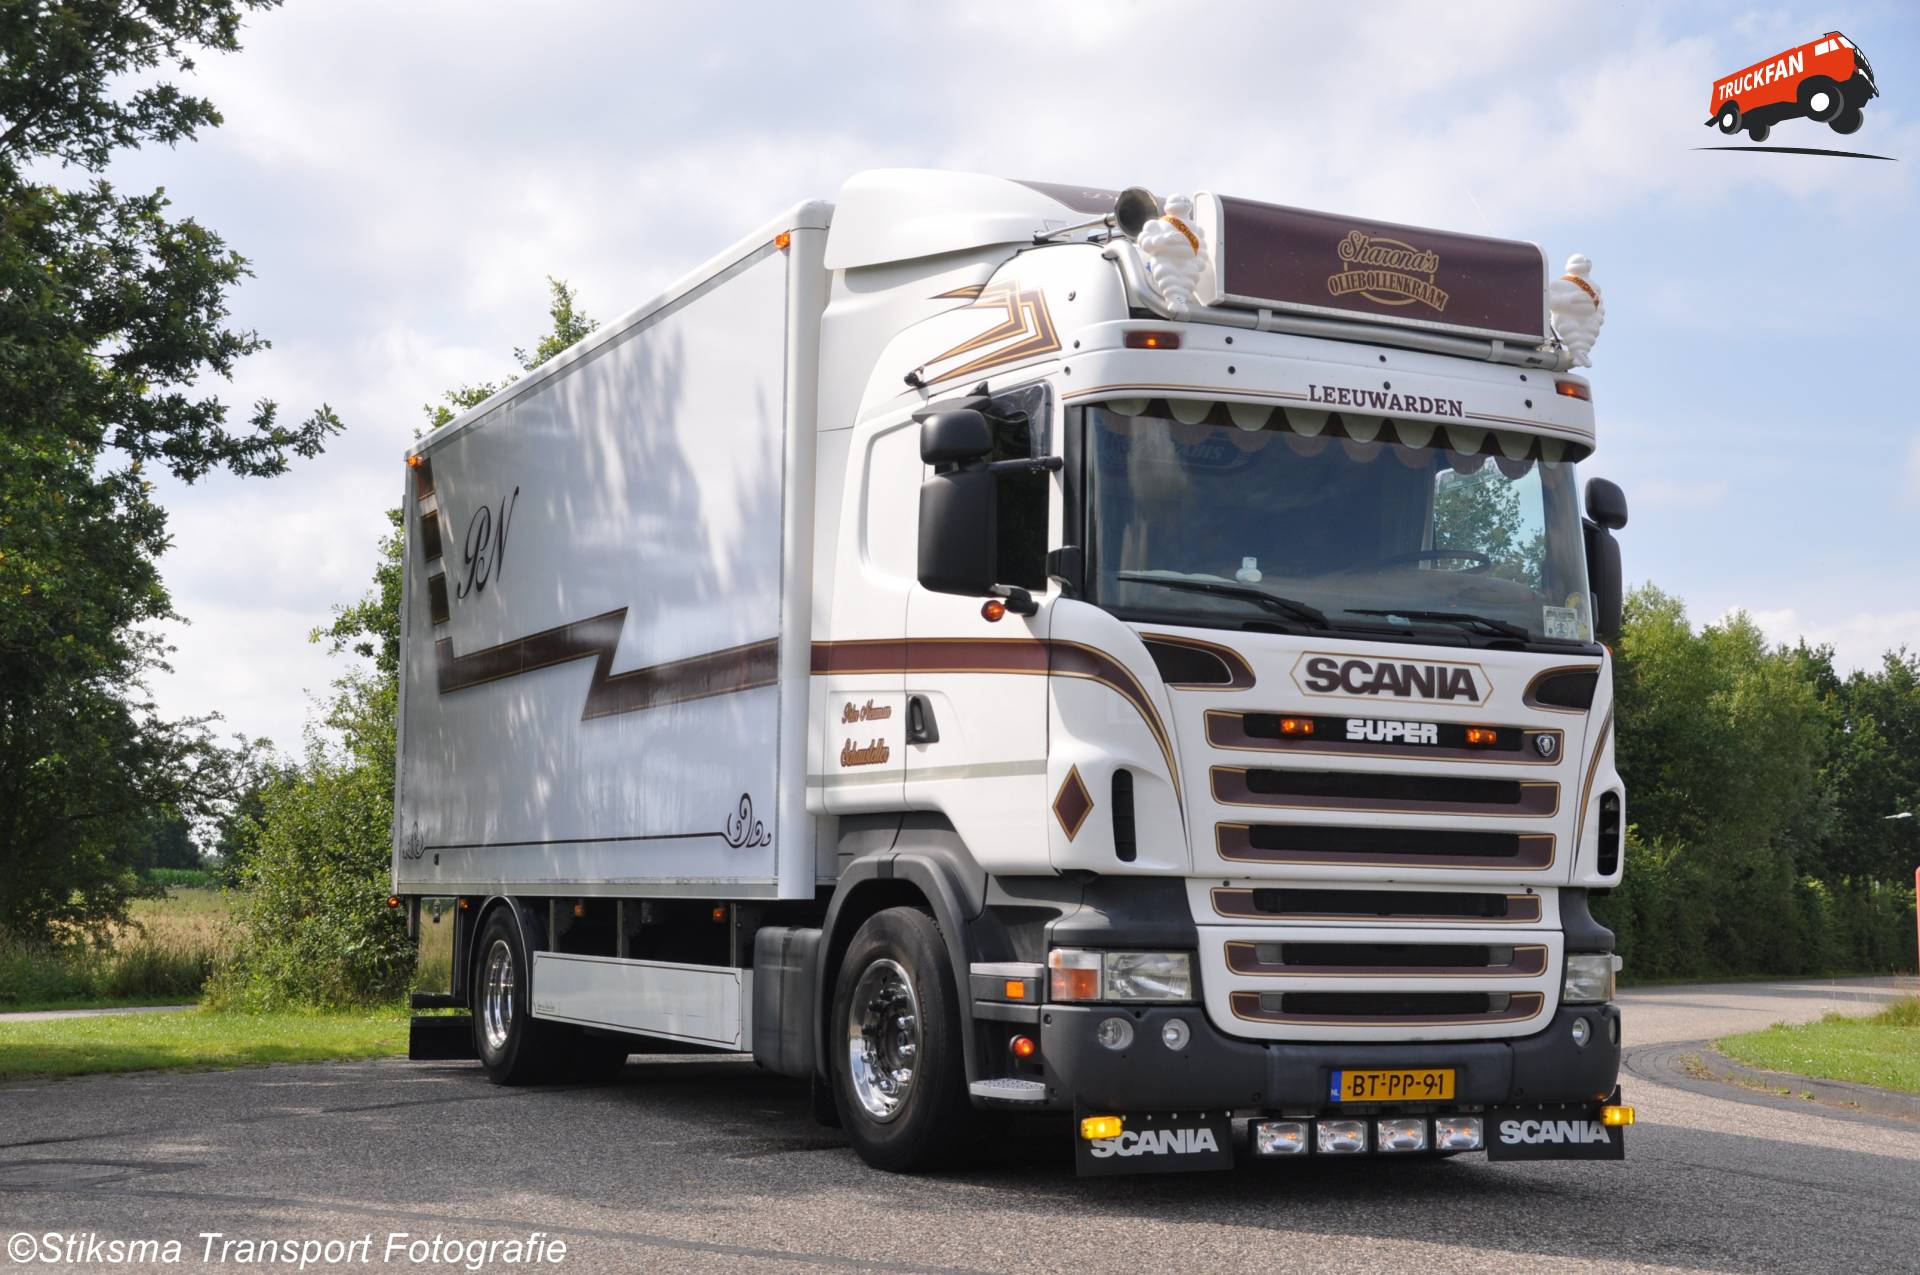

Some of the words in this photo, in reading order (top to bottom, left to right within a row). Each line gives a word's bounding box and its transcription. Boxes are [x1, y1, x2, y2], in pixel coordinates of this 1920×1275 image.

[1338, 230, 1439, 273] Sharona's
[1328, 270, 1448, 312] OLIEBOLLENKRAAM
[1308, 384, 1466, 418] LEEUWARDEN
[1305, 657, 1480, 702] SCANIA
[1346, 718, 1438, 745] SUPER
[1330, 1088, 1340, 1096] NL
[1352, 1073, 1444, 1096] BT-PP-91
[1090, 1127, 1220, 1158] SCANIA
[1499, 1119, 1611, 1144] SCANIA
